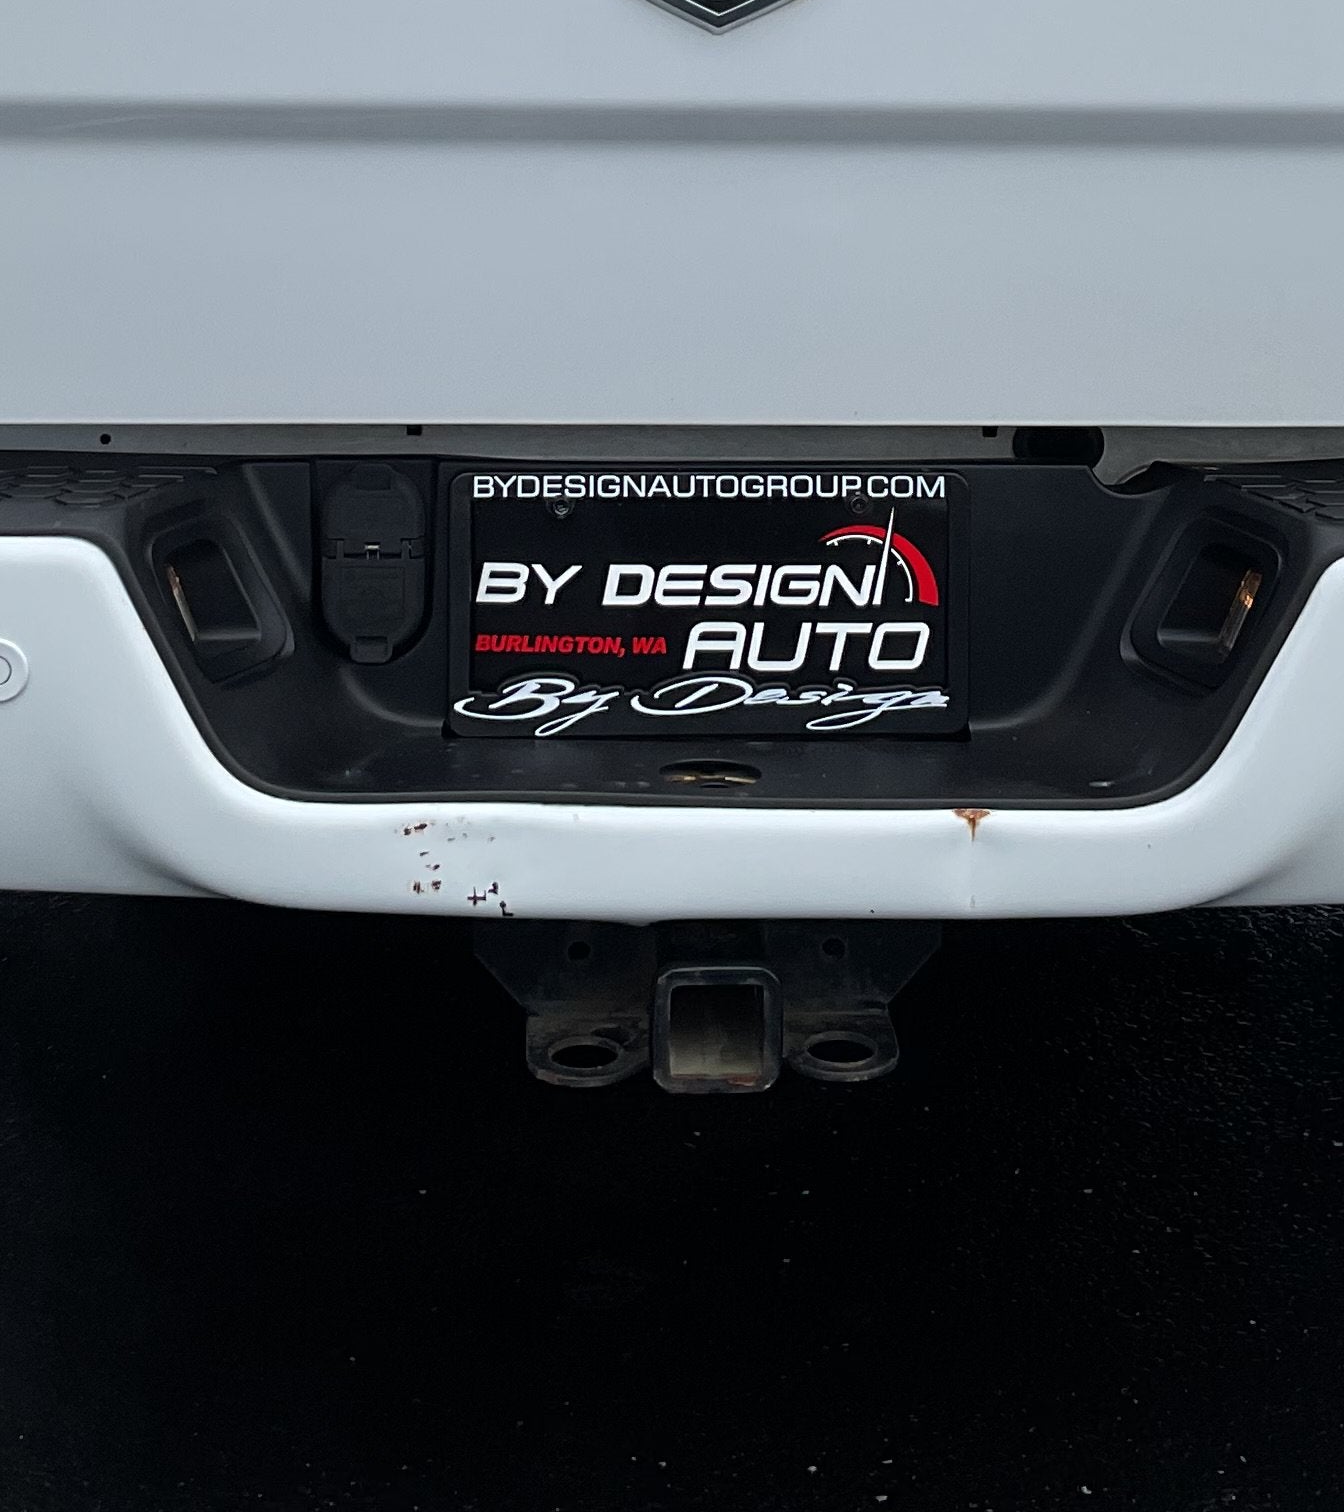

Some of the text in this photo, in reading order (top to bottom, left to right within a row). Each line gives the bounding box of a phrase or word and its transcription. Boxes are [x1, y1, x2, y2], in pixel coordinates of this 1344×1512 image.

[473, 475, 946, 498] BYDESIGNAUTOGROUP.COM
[475, 562, 883, 606] BY DESIGN
[475, 634, 668, 658] BURLINGTON, WA
[682, 622, 930, 671] AUTO
[453, 676, 951, 737] By Design
